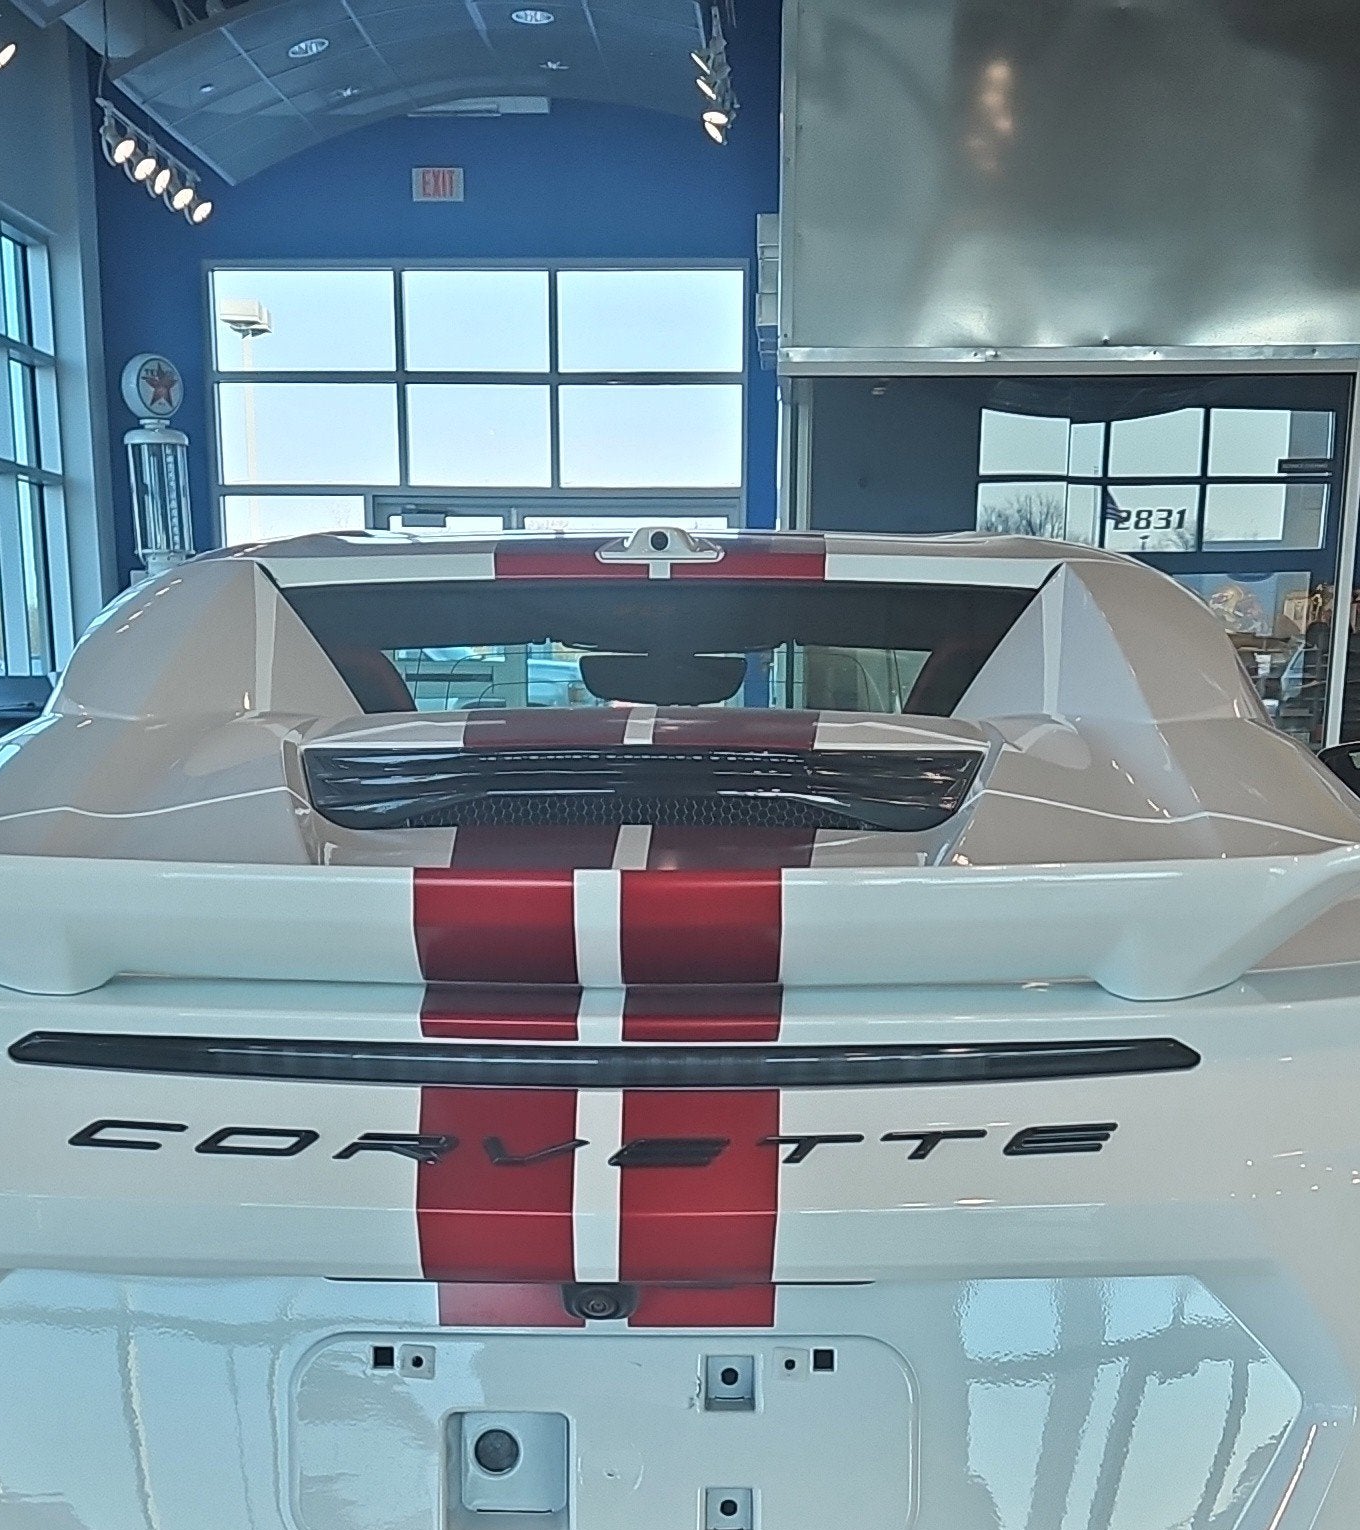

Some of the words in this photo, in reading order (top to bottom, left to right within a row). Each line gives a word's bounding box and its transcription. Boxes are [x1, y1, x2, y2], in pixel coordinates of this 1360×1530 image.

[422, 169, 455, 198] EXIT
[1113, 508, 1187, 530] 2831
[67, 1119, 1118, 1168] CORVETTE
